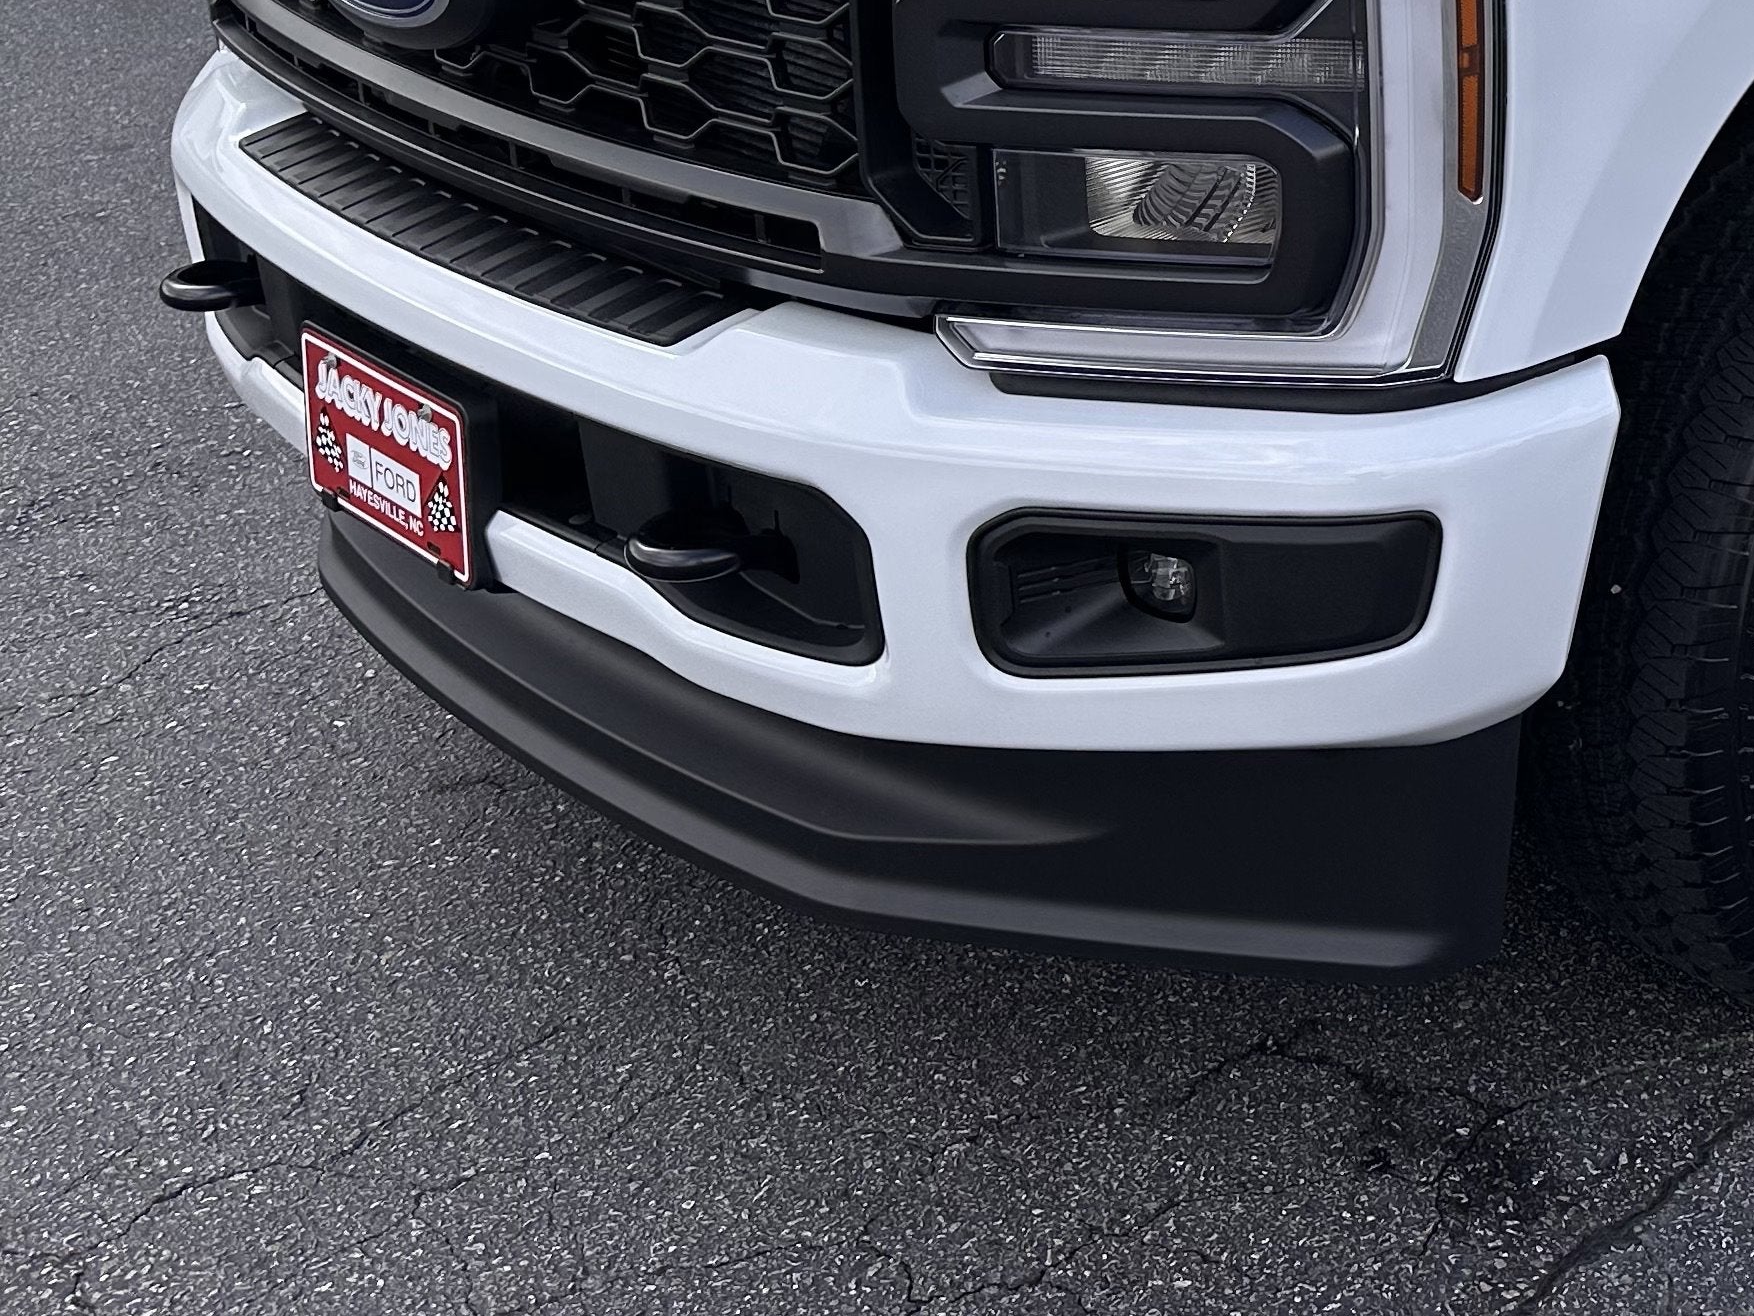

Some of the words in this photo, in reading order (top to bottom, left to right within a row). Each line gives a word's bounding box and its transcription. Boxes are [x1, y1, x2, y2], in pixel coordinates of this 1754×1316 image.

[315, 360, 382, 431] JACKY
[381, 399, 452, 471] JONES
[349, 479, 409, 530] HAYESVILLE,
[410, 516, 424, 537] NC
[375, 461, 416, 502] FORD
